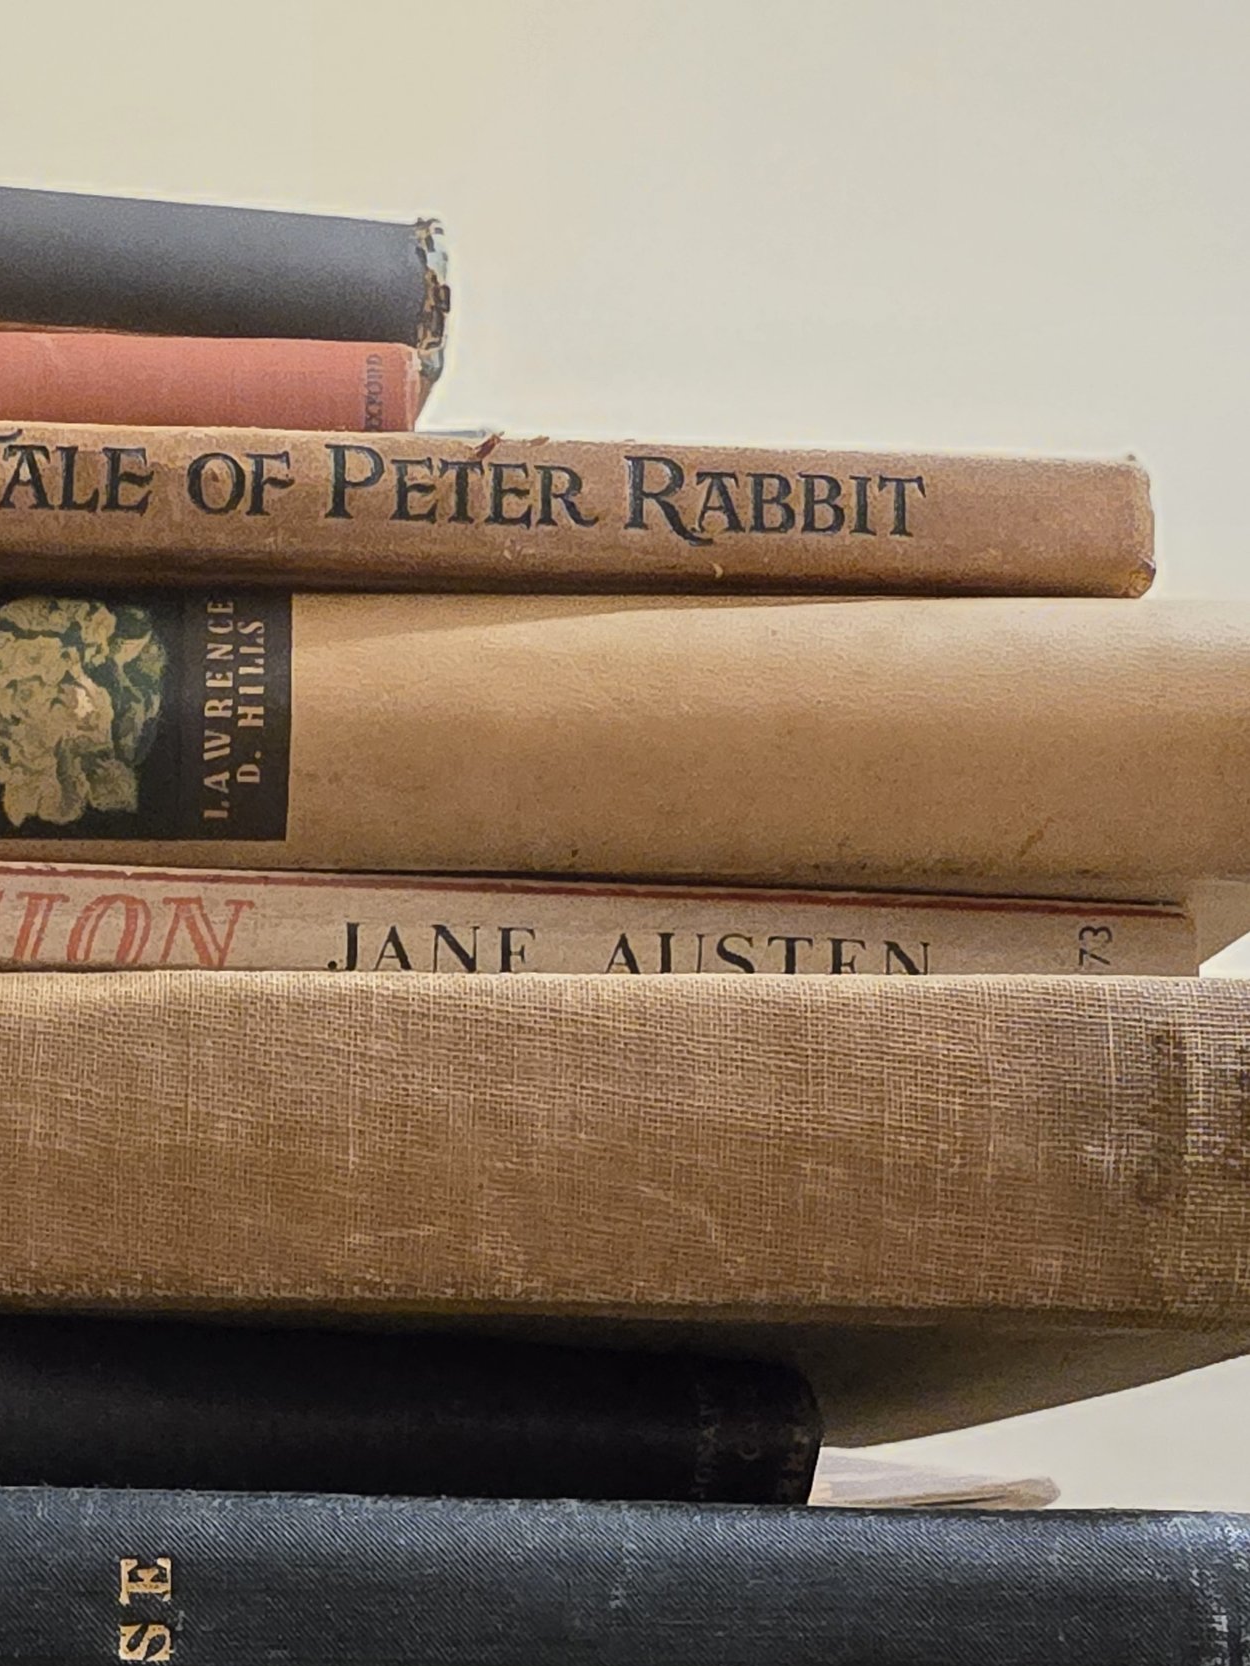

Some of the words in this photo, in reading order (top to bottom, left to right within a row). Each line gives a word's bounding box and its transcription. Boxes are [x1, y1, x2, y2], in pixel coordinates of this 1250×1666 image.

[186, 448, 295, 517] OF
[323, 443, 600, 530] PETER
[623, 455, 928, 547] RABBIT
[203, 600, 234, 819] LAWRENCE
[237, 620, 266, 727] HILLS
[236, 750, 262, 783] D.
[327, 920, 536, 973] JANE
[605, 930, 931, 975] AUSTEN
[1076, 925, 1114, 968] 73
